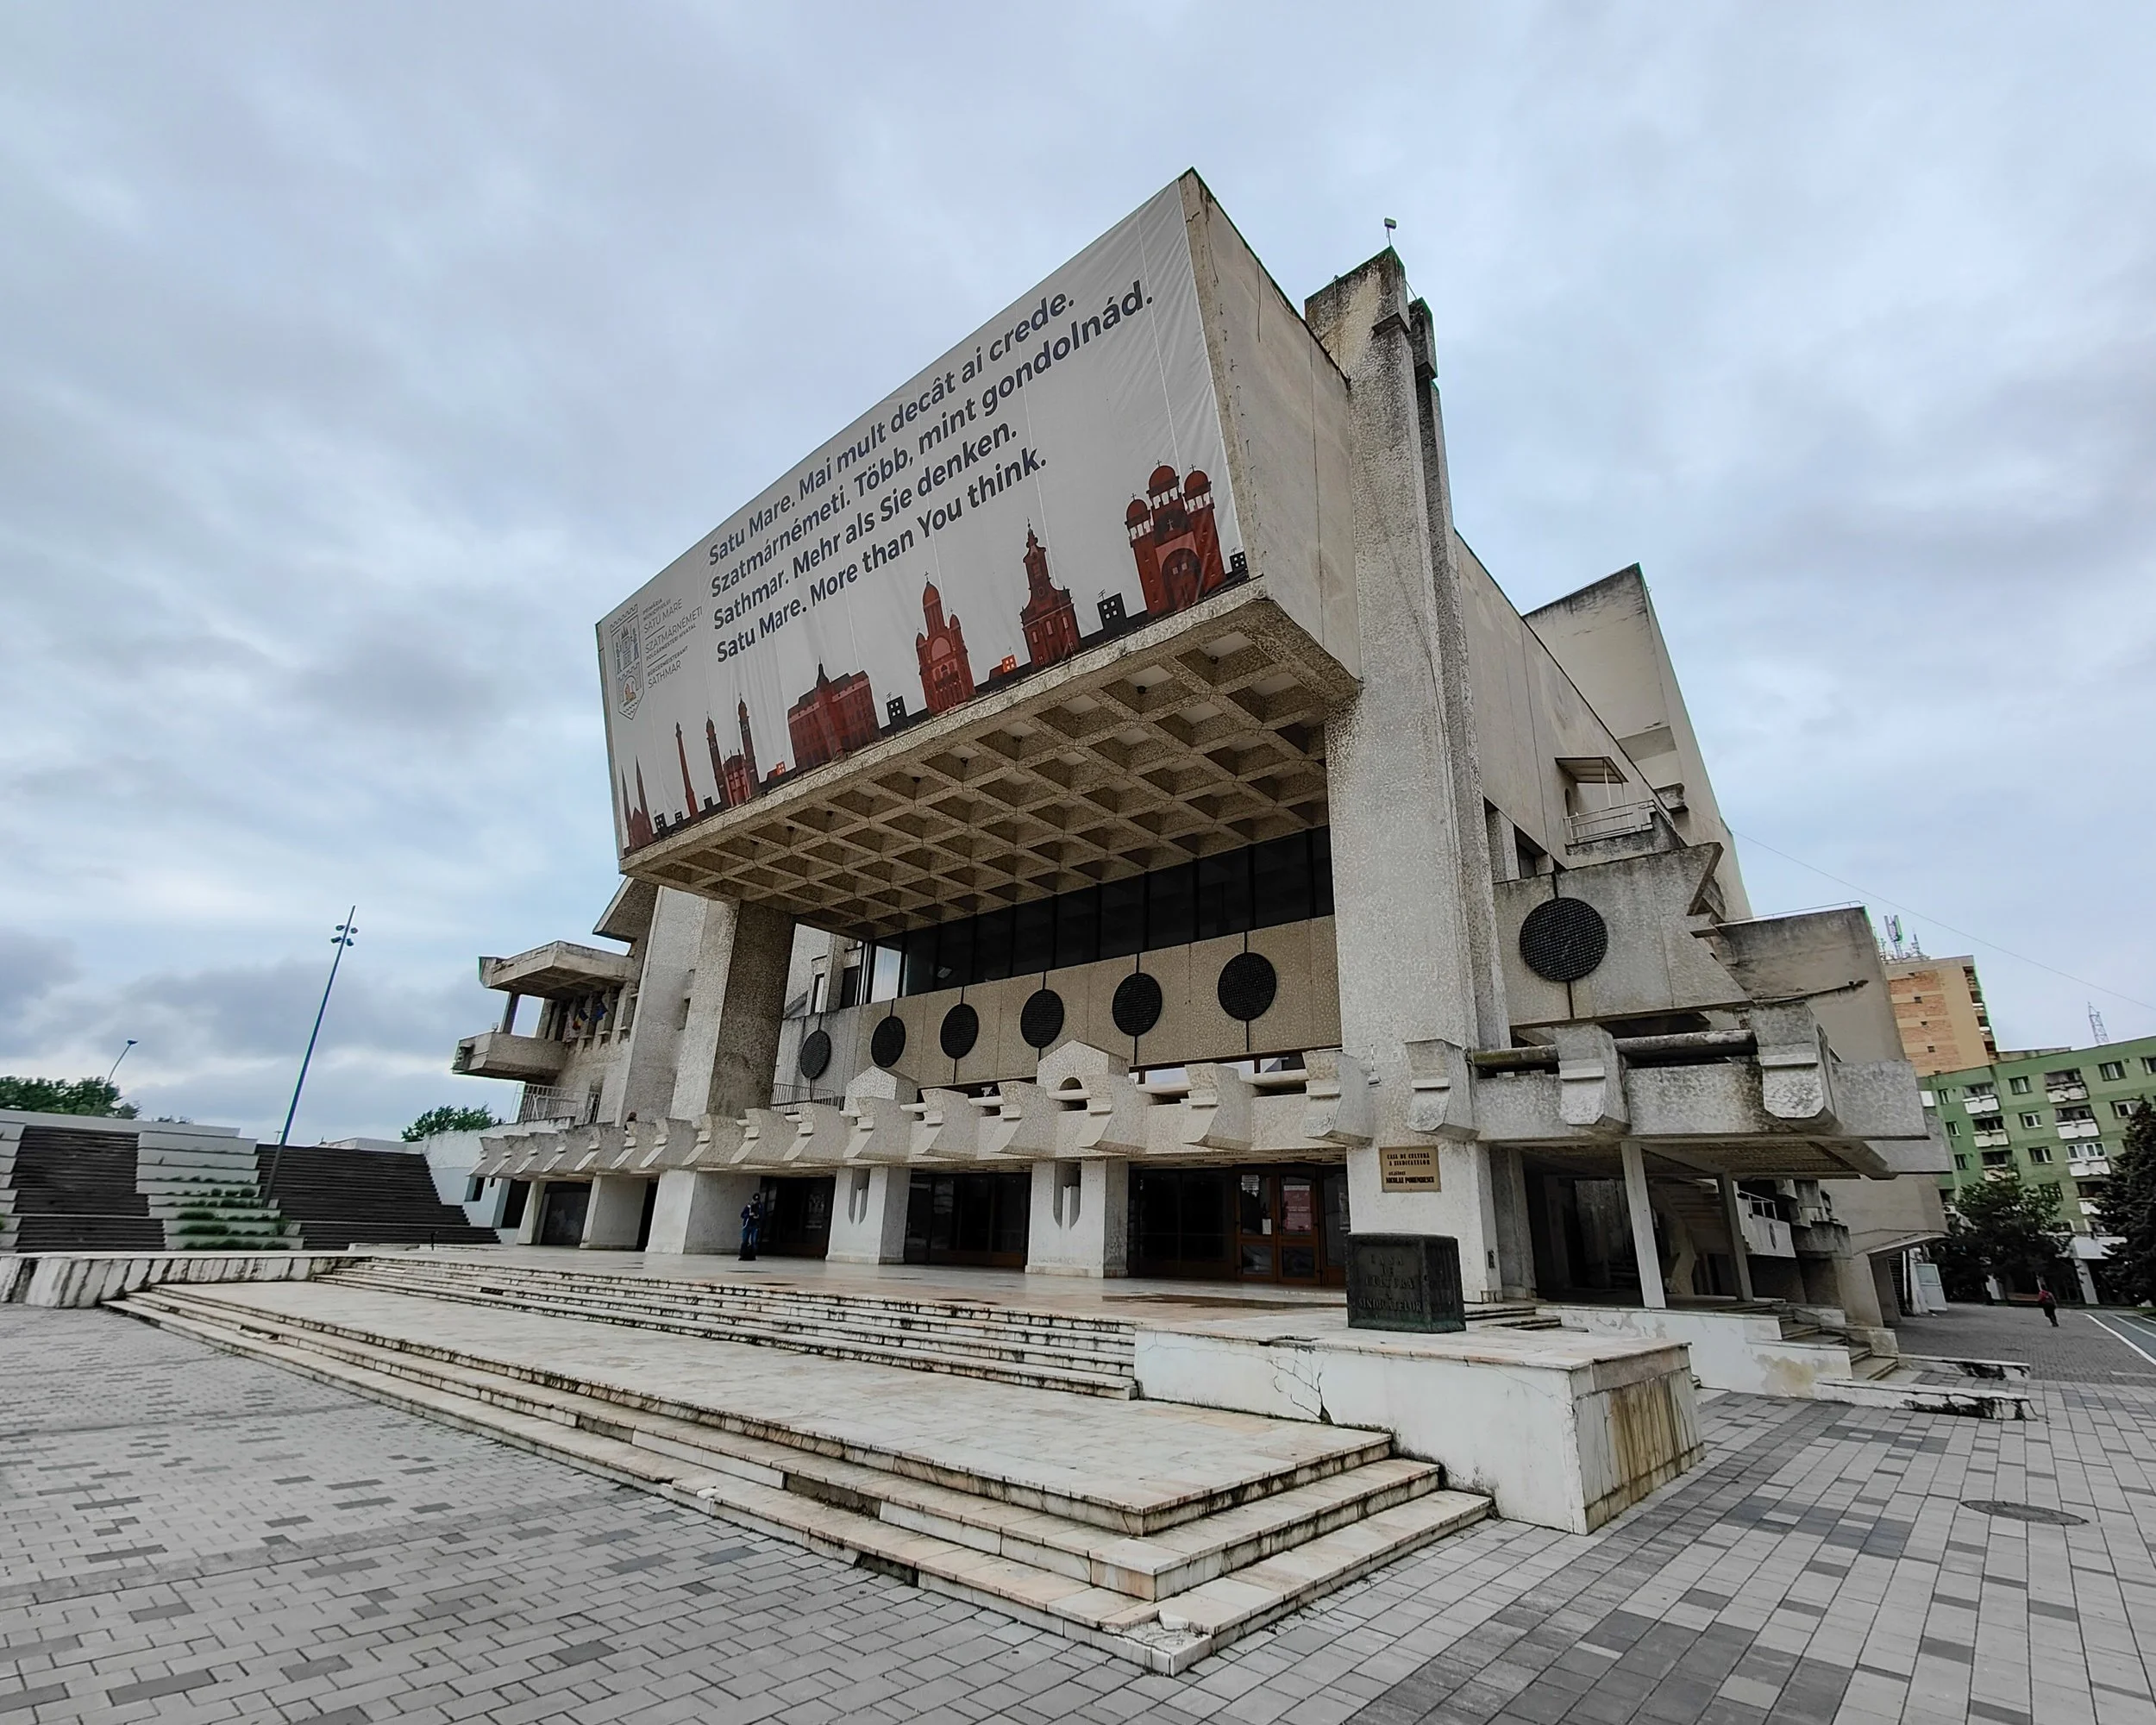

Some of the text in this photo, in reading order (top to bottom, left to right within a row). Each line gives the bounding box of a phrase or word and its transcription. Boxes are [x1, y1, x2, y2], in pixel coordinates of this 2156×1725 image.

[709, 293, 1075, 566] Satu Mare. Mai mult decât ai crede.
[711, 279, 1153, 598] Szatmárnémeti. Több, mint gondolnád.
[713, 423, 1017, 630] Sathmar. Mehr als Sie denken.
[717, 447, 1047, 662] Satu Mare. More than You think.
[643, 598, 683, 634] SATU MARE
[644, 605, 703, 654] SZATMÁRNÉMETI
[648, 660, 681, 689] SATHMAR
[1358, 1296, 1422, 1313] SINDICATELOR
